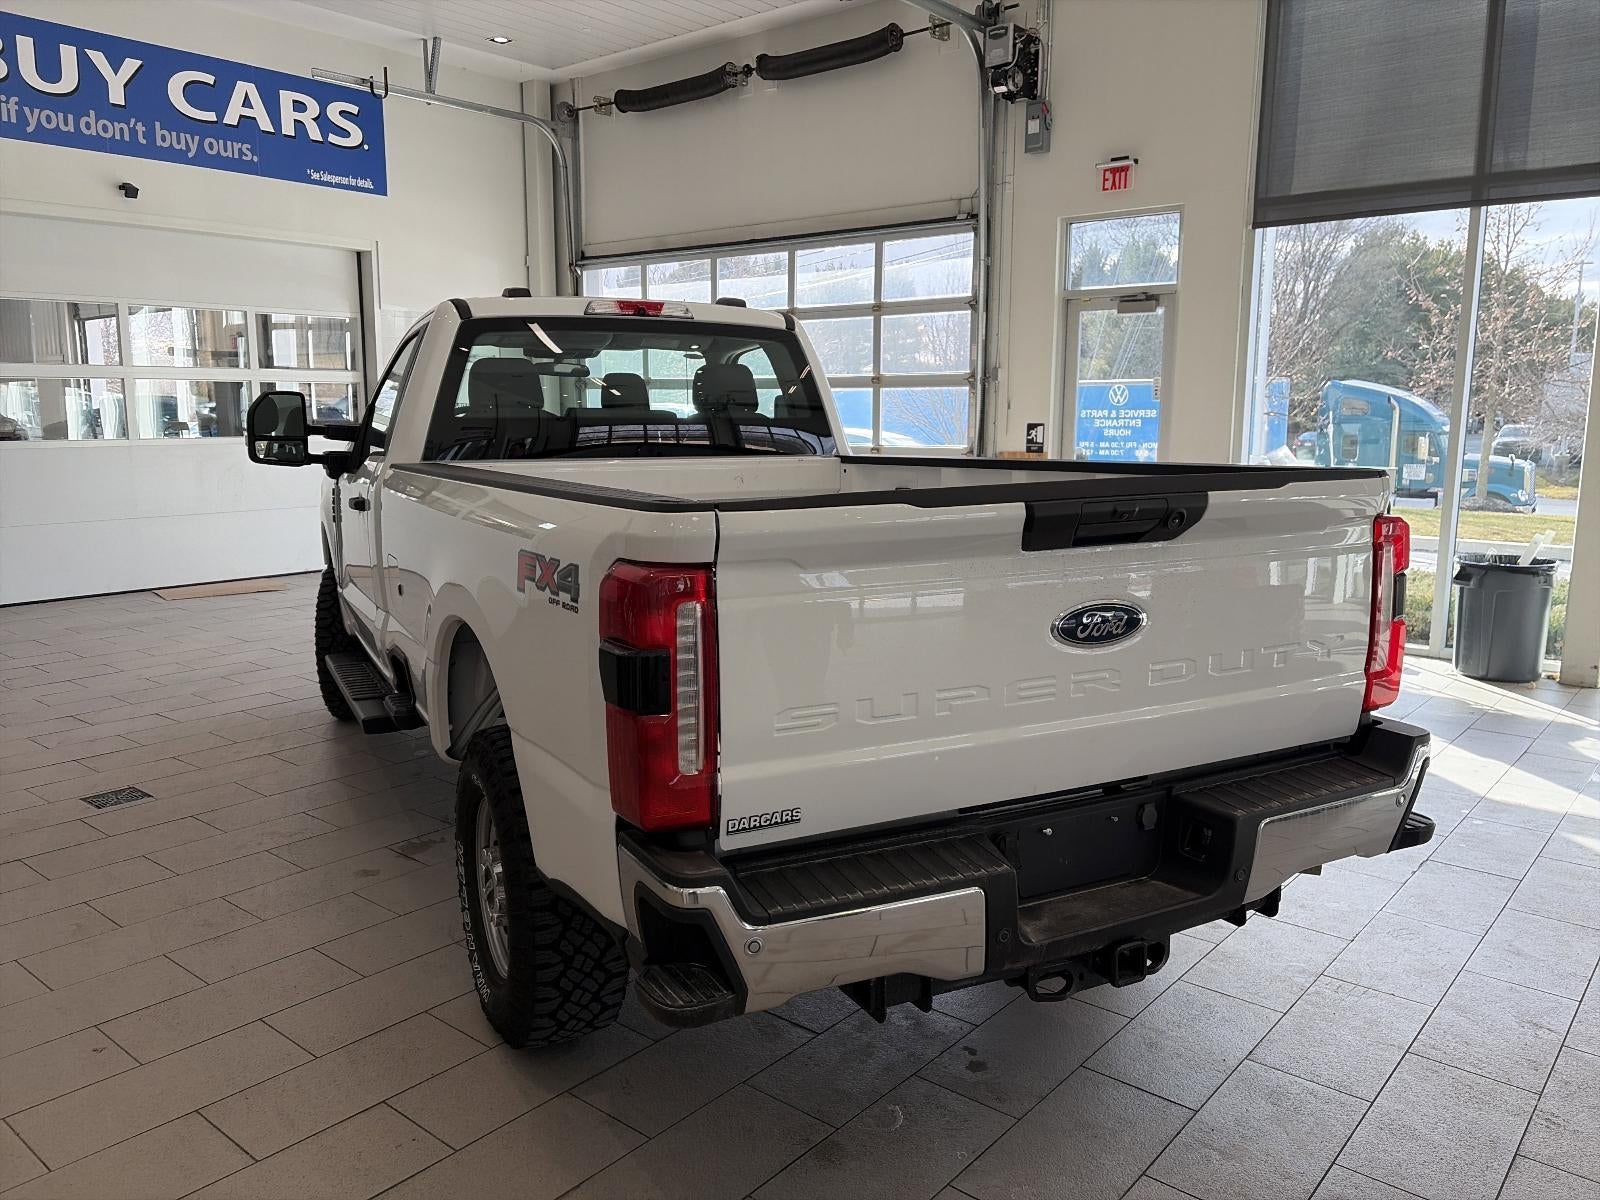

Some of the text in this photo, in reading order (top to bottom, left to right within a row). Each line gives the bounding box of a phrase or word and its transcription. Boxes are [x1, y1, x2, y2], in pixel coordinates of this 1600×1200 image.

[0, 34, 144, 107] UY
[0, 95, 258, 162] if you don't buy ours.
[311, 169, 320, 180] See
[320, 170, 350, 186] Salesperson
[1102, 165, 1130, 191] EXIT
[517, 549, 580, 604] FX4
[548, 596, 579, 614] OFF ROAD
[1077, 611, 1128, 639] Ford
[773, 634, 1345, 737] SUPER DUTY
[726, 807, 802, 835] DARCARS
